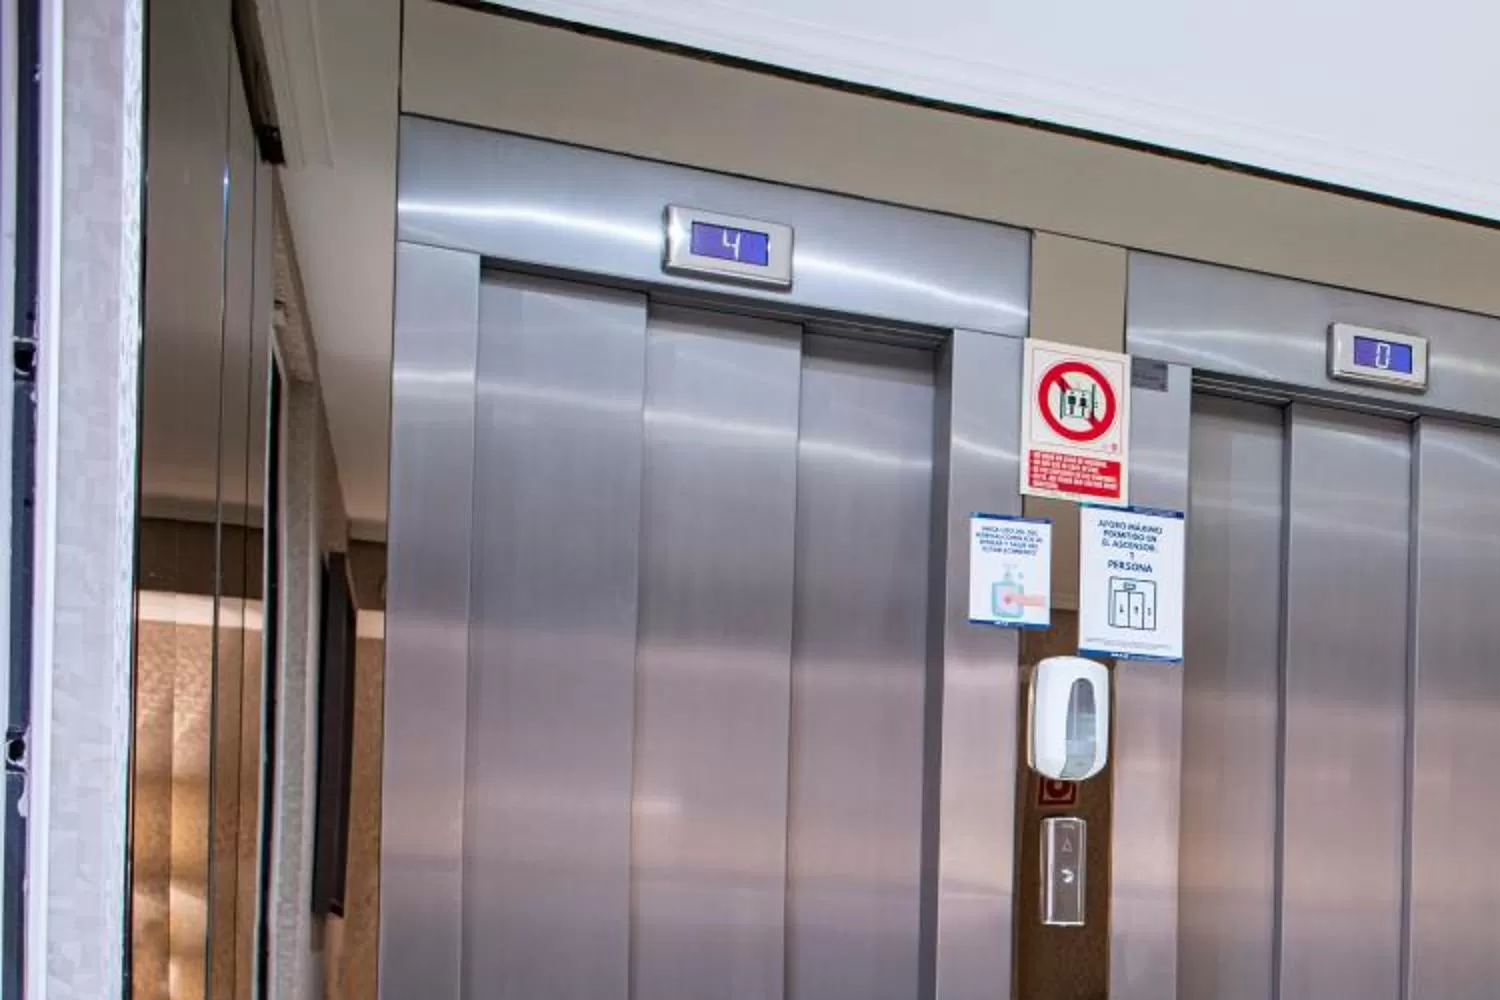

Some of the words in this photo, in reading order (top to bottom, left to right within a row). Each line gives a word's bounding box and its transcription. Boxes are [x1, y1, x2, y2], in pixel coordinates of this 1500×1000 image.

[722, 229, 740, 260] 4
[1375, 342, 1391, 369] 0
[1097, 519, 1126, 530] AFORO
[1107, 559, 1152, 573] PERSONA
